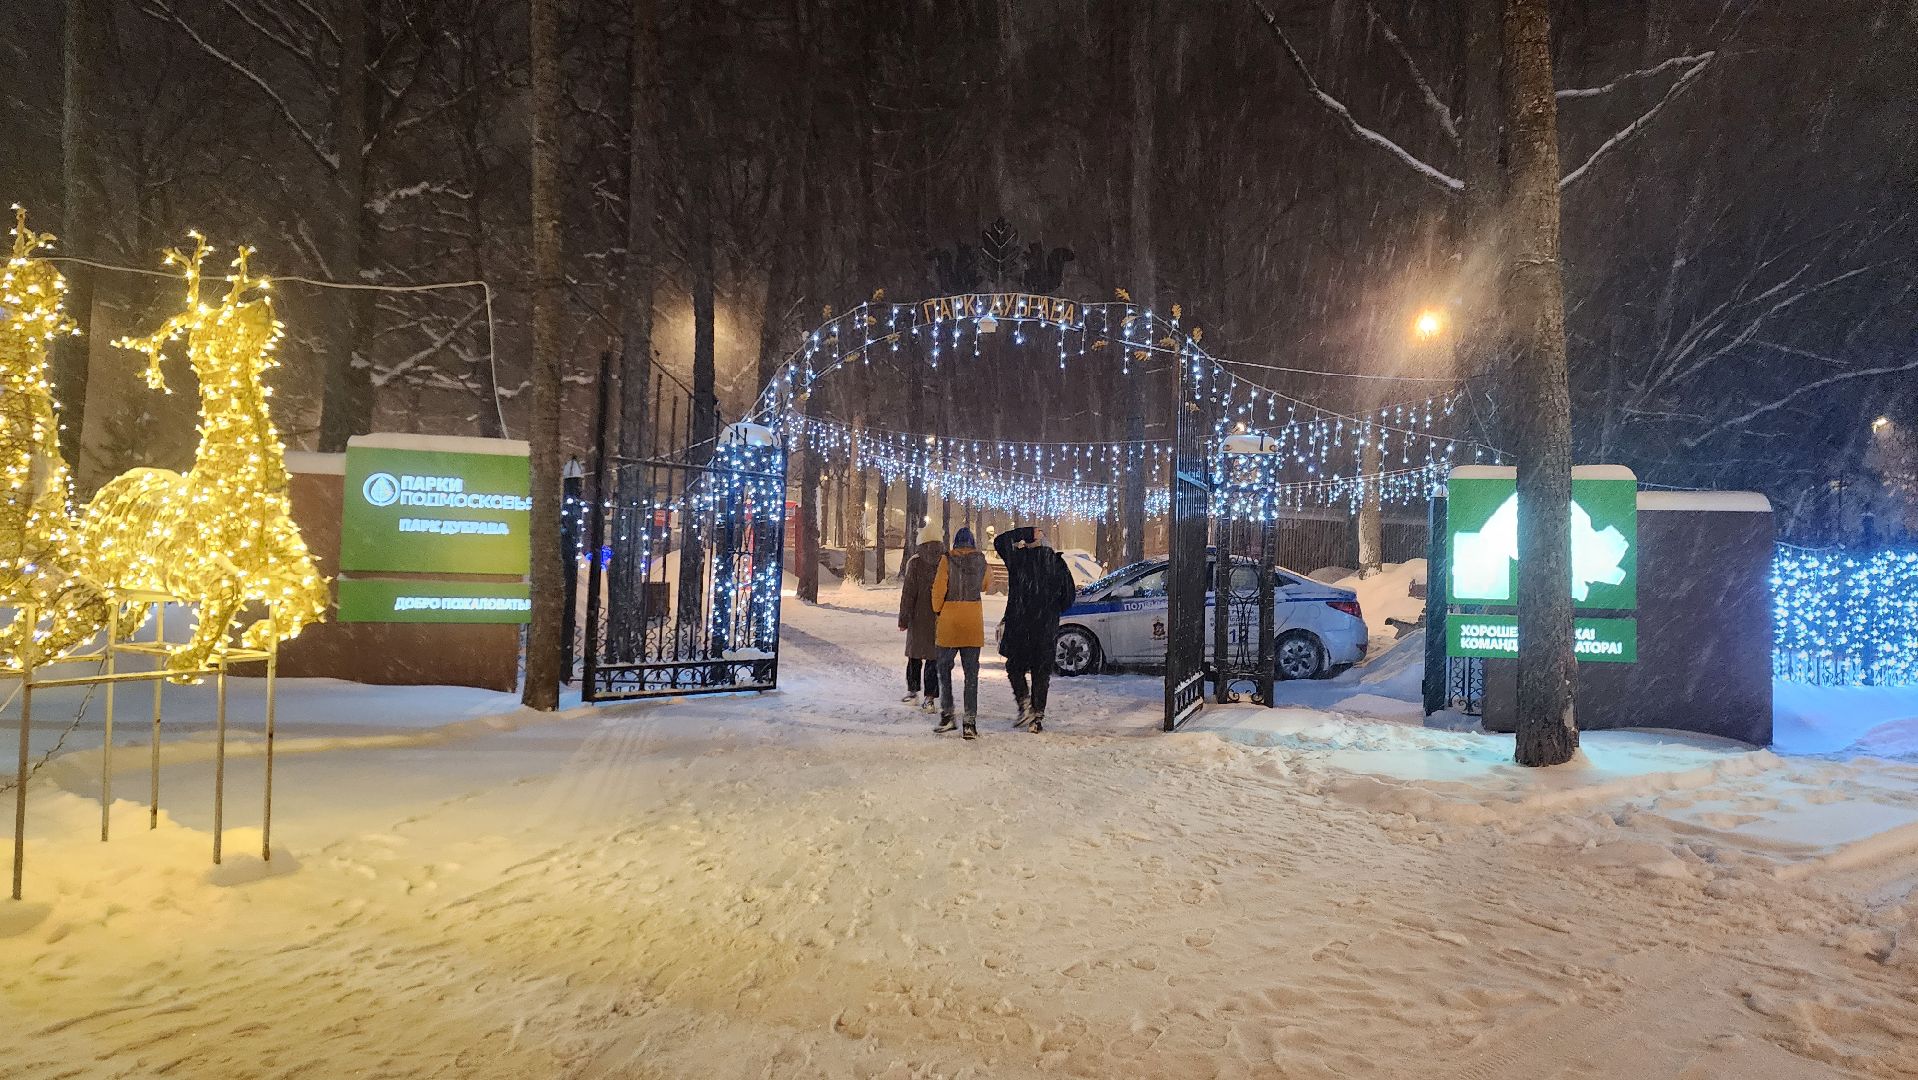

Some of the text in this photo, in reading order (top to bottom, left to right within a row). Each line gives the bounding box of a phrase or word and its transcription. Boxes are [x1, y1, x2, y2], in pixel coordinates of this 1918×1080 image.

[923, 294, 1074, 326] ПАРК ДУБРАВА
[400, 475, 464, 493] ПАРКИ
[398, 518, 510, 535] ПАРК ДУБРАВА
[394, 596, 441, 610] ДОБРО
[1460, 624, 1519, 638] ХОРОШЕ
[1460, 636, 1623, 655] КОМАНД АТОРА!
